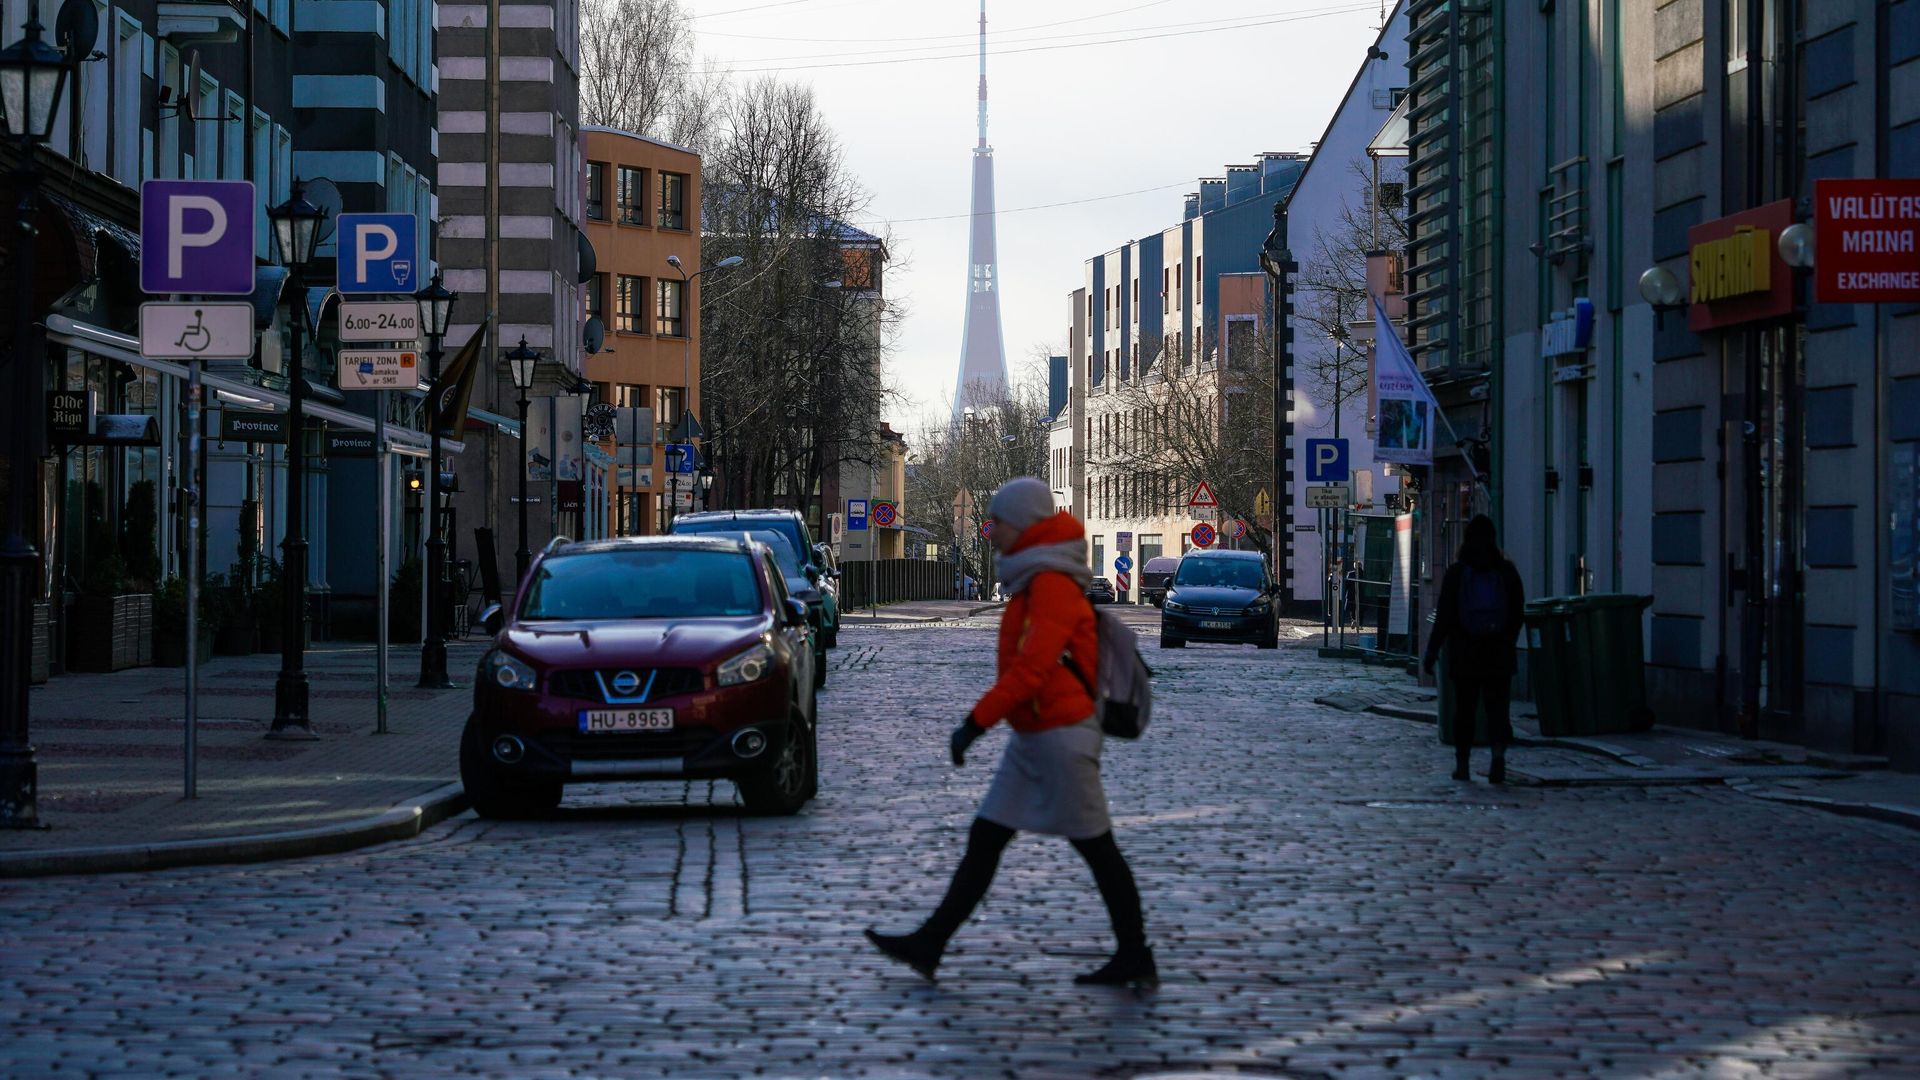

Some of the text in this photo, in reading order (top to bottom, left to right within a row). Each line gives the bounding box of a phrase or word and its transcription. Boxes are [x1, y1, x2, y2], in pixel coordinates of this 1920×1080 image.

[168, 195, 228, 279] P
[356, 223, 399, 284] P
[1837, 272, 1920, 289] EXCHANGE
[345, 313, 415, 330] 6.00-24.00
[376, 356, 398, 365] ZONA
[403, 356, 412, 365] R
[371, 368, 399, 376] amaksa
[53, 395, 84, 410] Olde
[53, 410, 82, 426] Riga
[232, 420, 280, 432] Province
[331, 438, 372, 448] Province
[1315, 443, 1339, 477] P
[591, 711, 670, 728] HU-8963
